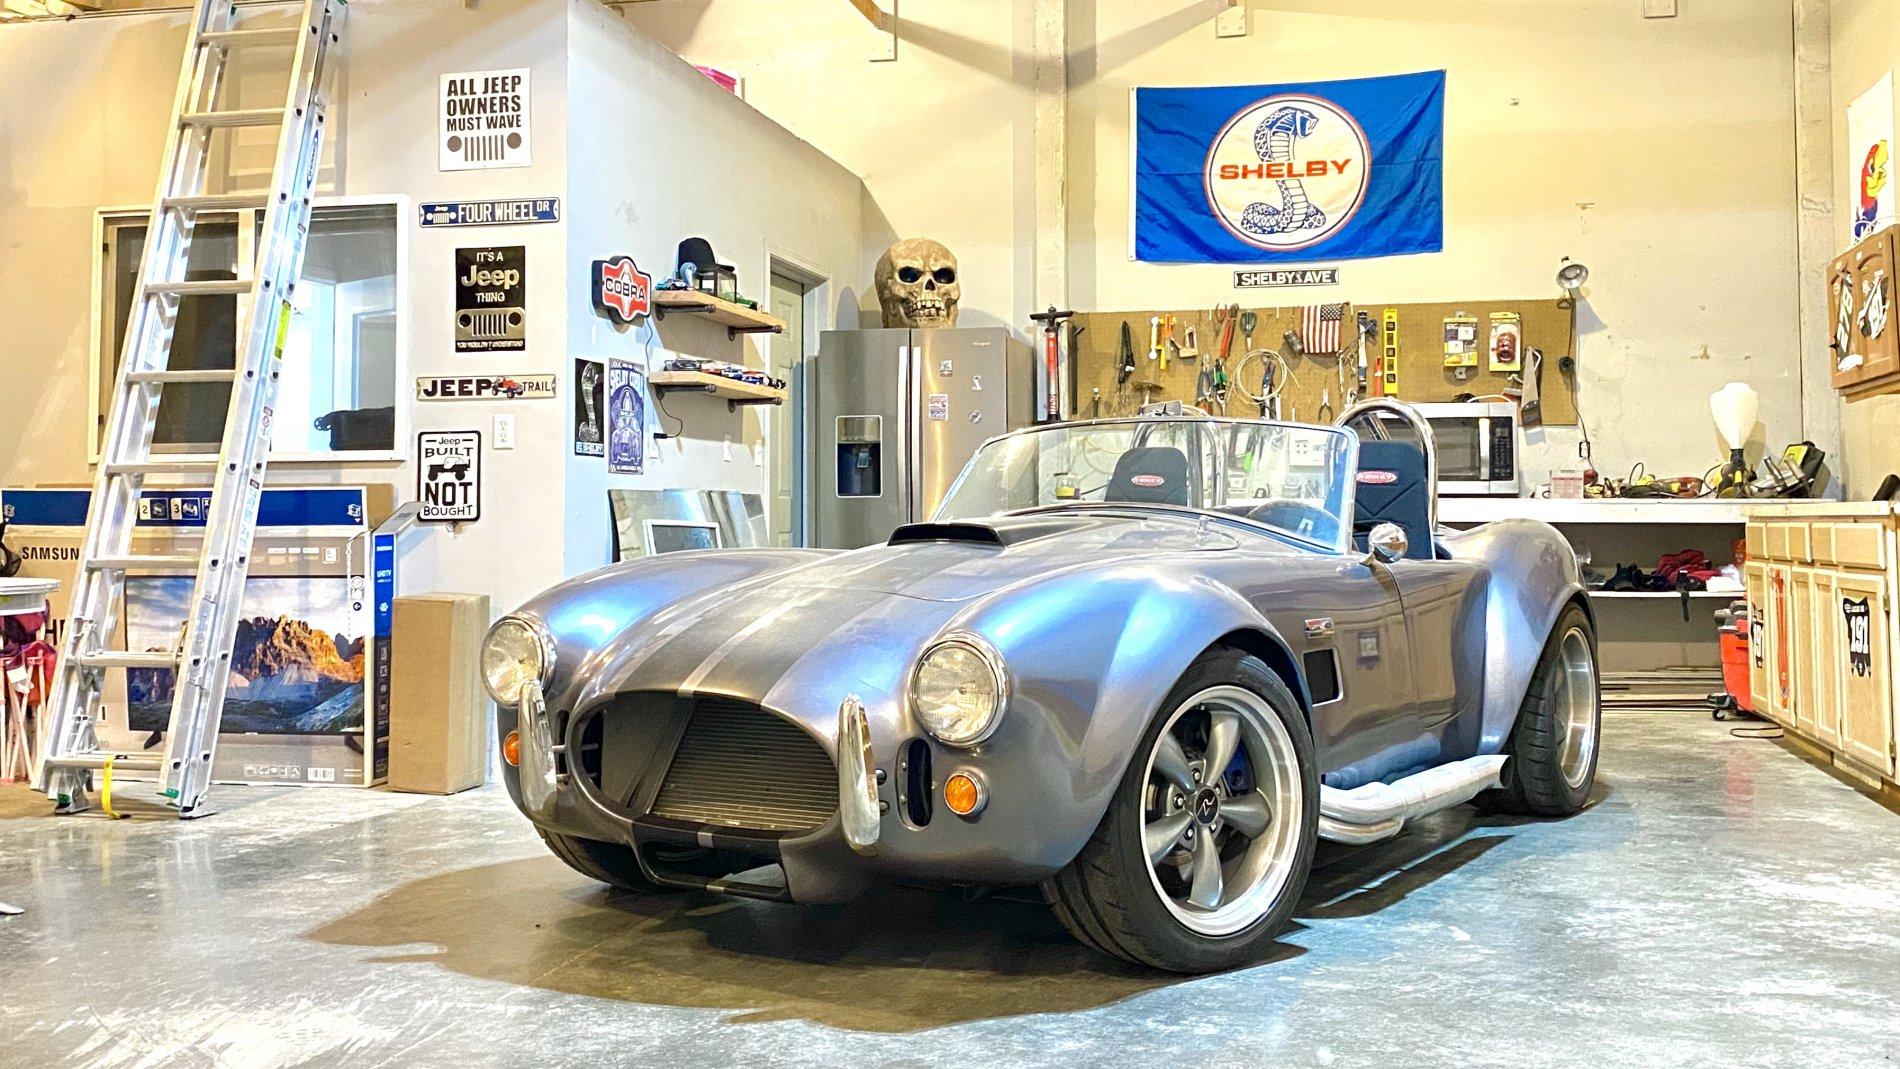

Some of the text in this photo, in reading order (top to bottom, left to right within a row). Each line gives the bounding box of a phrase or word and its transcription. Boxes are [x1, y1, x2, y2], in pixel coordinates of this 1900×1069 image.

[447, 75, 521, 97] ALL JEEP
[446, 95, 521, 116] OWNERS
[446, 114, 522, 132] MUST WAVE
[1219, 158, 1353, 180] SHELBY
[458, 200, 549, 223] FOUR WHEEL DR
[476, 251, 504, 263] IT'S A
[461, 265, 520, 289] Jeep
[1241, 270, 1332, 286] SHELBY AVE
[475, 291, 505, 303] THING
[605, 277, 646, 301] COBRA
[422, 379, 551, 397] JEEP TRAIL
[438, 437, 461, 446] Jeep
[425, 447, 474, 458] BUILT
[425, 482, 473, 506] NOT
[142, 505, 148, 514] 2
[173, 504, 180, 513] 3
[423, 504, 473, 516] BOUGHT
[22, 546, 80, 560] SAMSUN
[1850, 615, 1869, 654] 191
